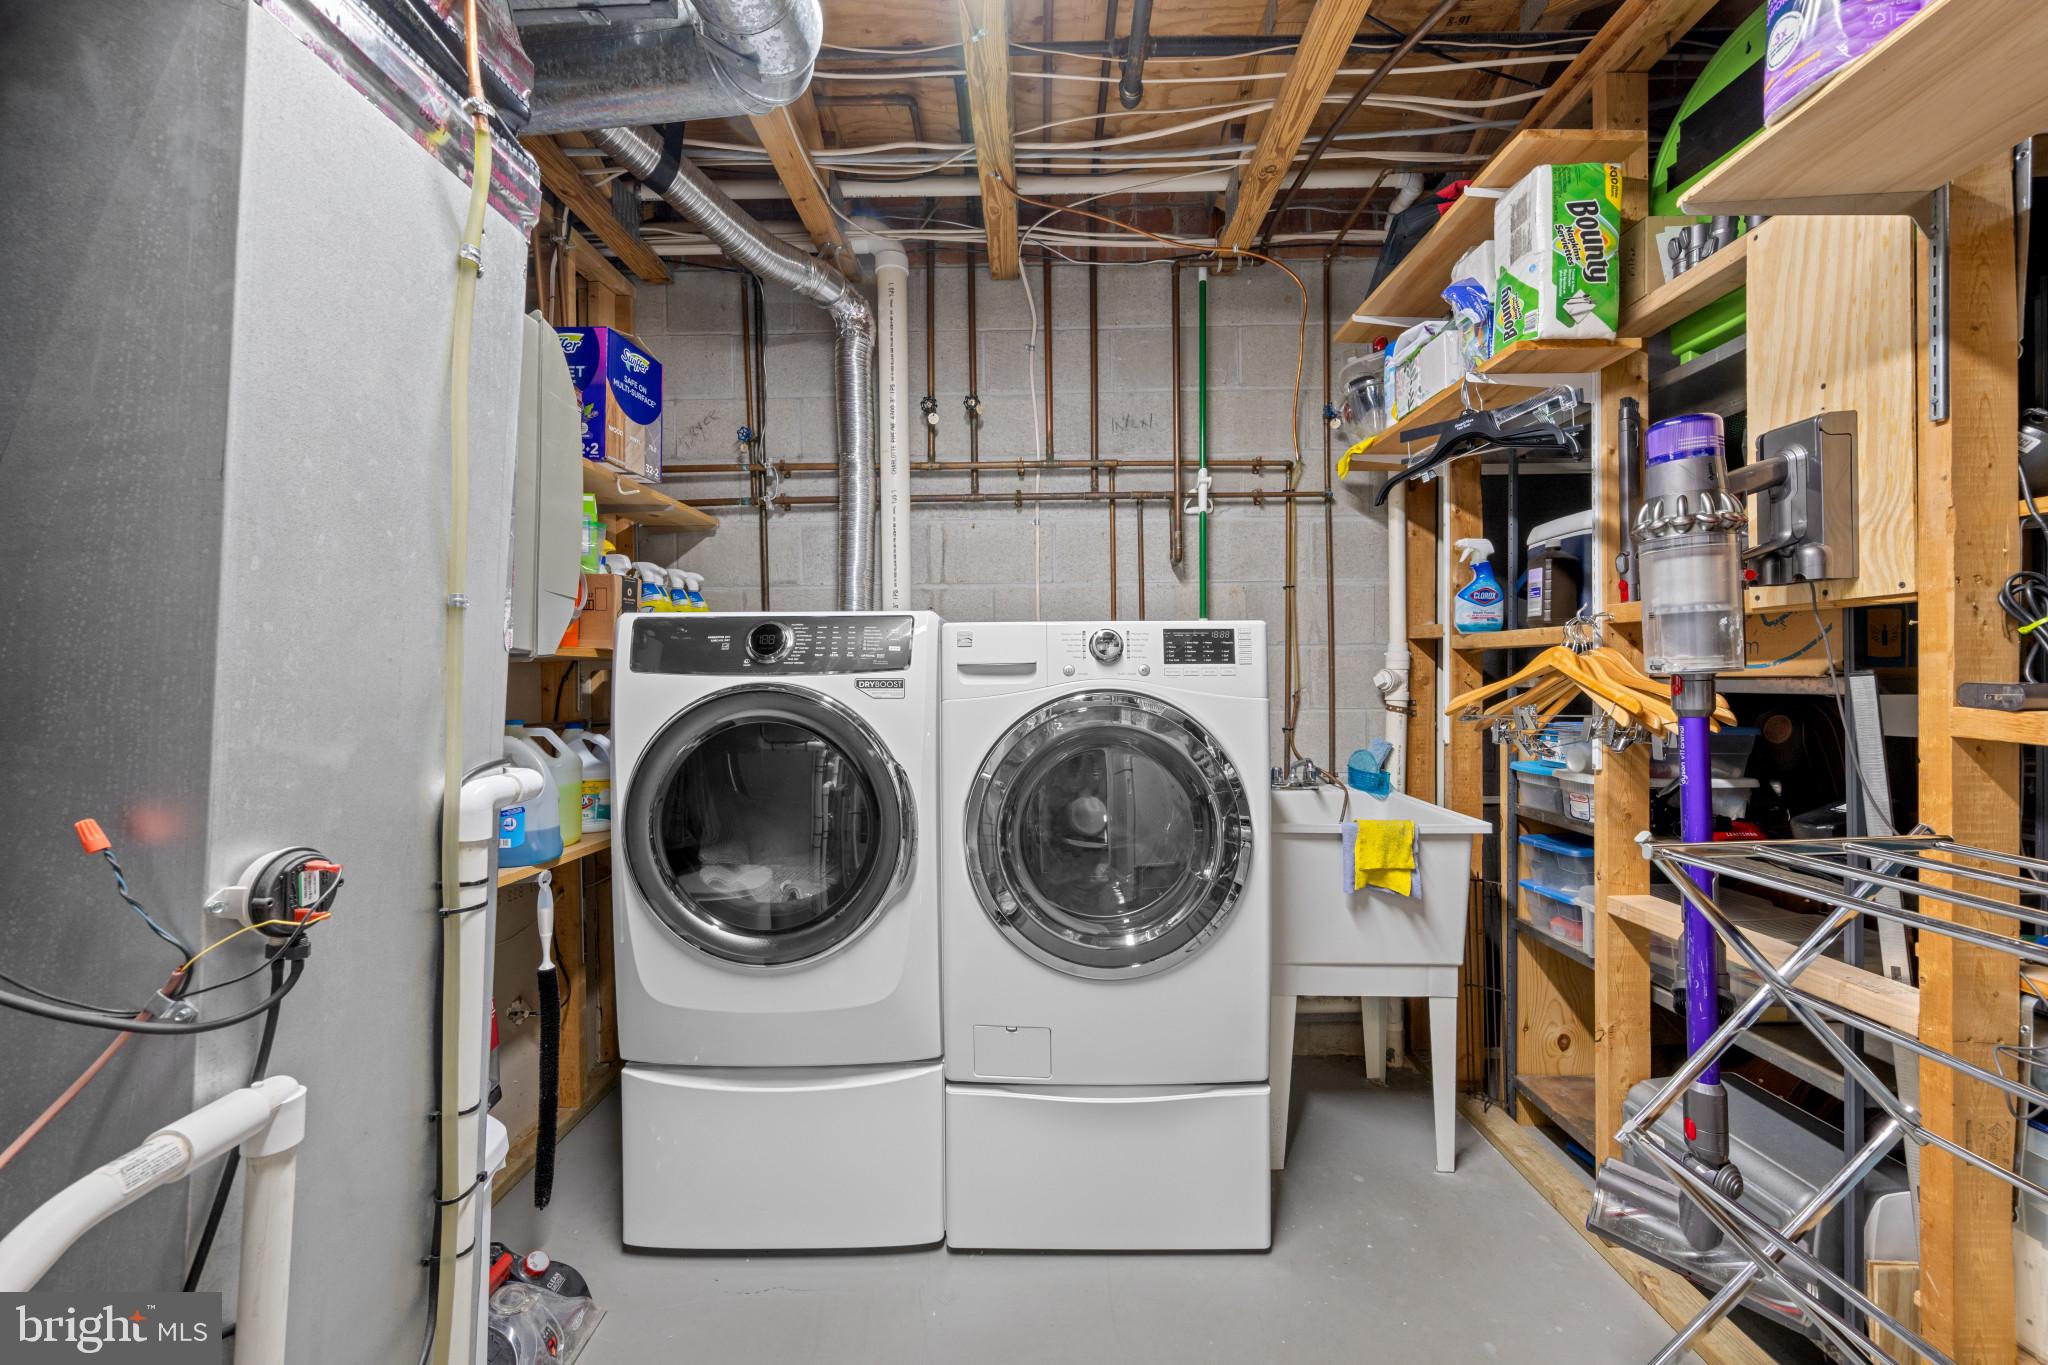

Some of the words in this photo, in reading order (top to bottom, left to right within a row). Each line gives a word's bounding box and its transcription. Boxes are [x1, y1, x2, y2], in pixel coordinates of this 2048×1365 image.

[1555, 224, 1576, 266] Serviettes
[1565, 199, 1610, 285] Bounty
[1565, 226, 1581, 261] Napkins
[1501, 285, 1518, 343] Bounty
[620, 348, 650, 375] Swiffer
[623, 374, 639, 391] SAFE
[638, 384, 648, 394] ON
[1473, 591, 1496, 600] CLOROX
[858, 680, 902, 689] DRYBOOST
[1678, 725, 1686, 750] animal
[1679, 761, 1689, 786] dyson
